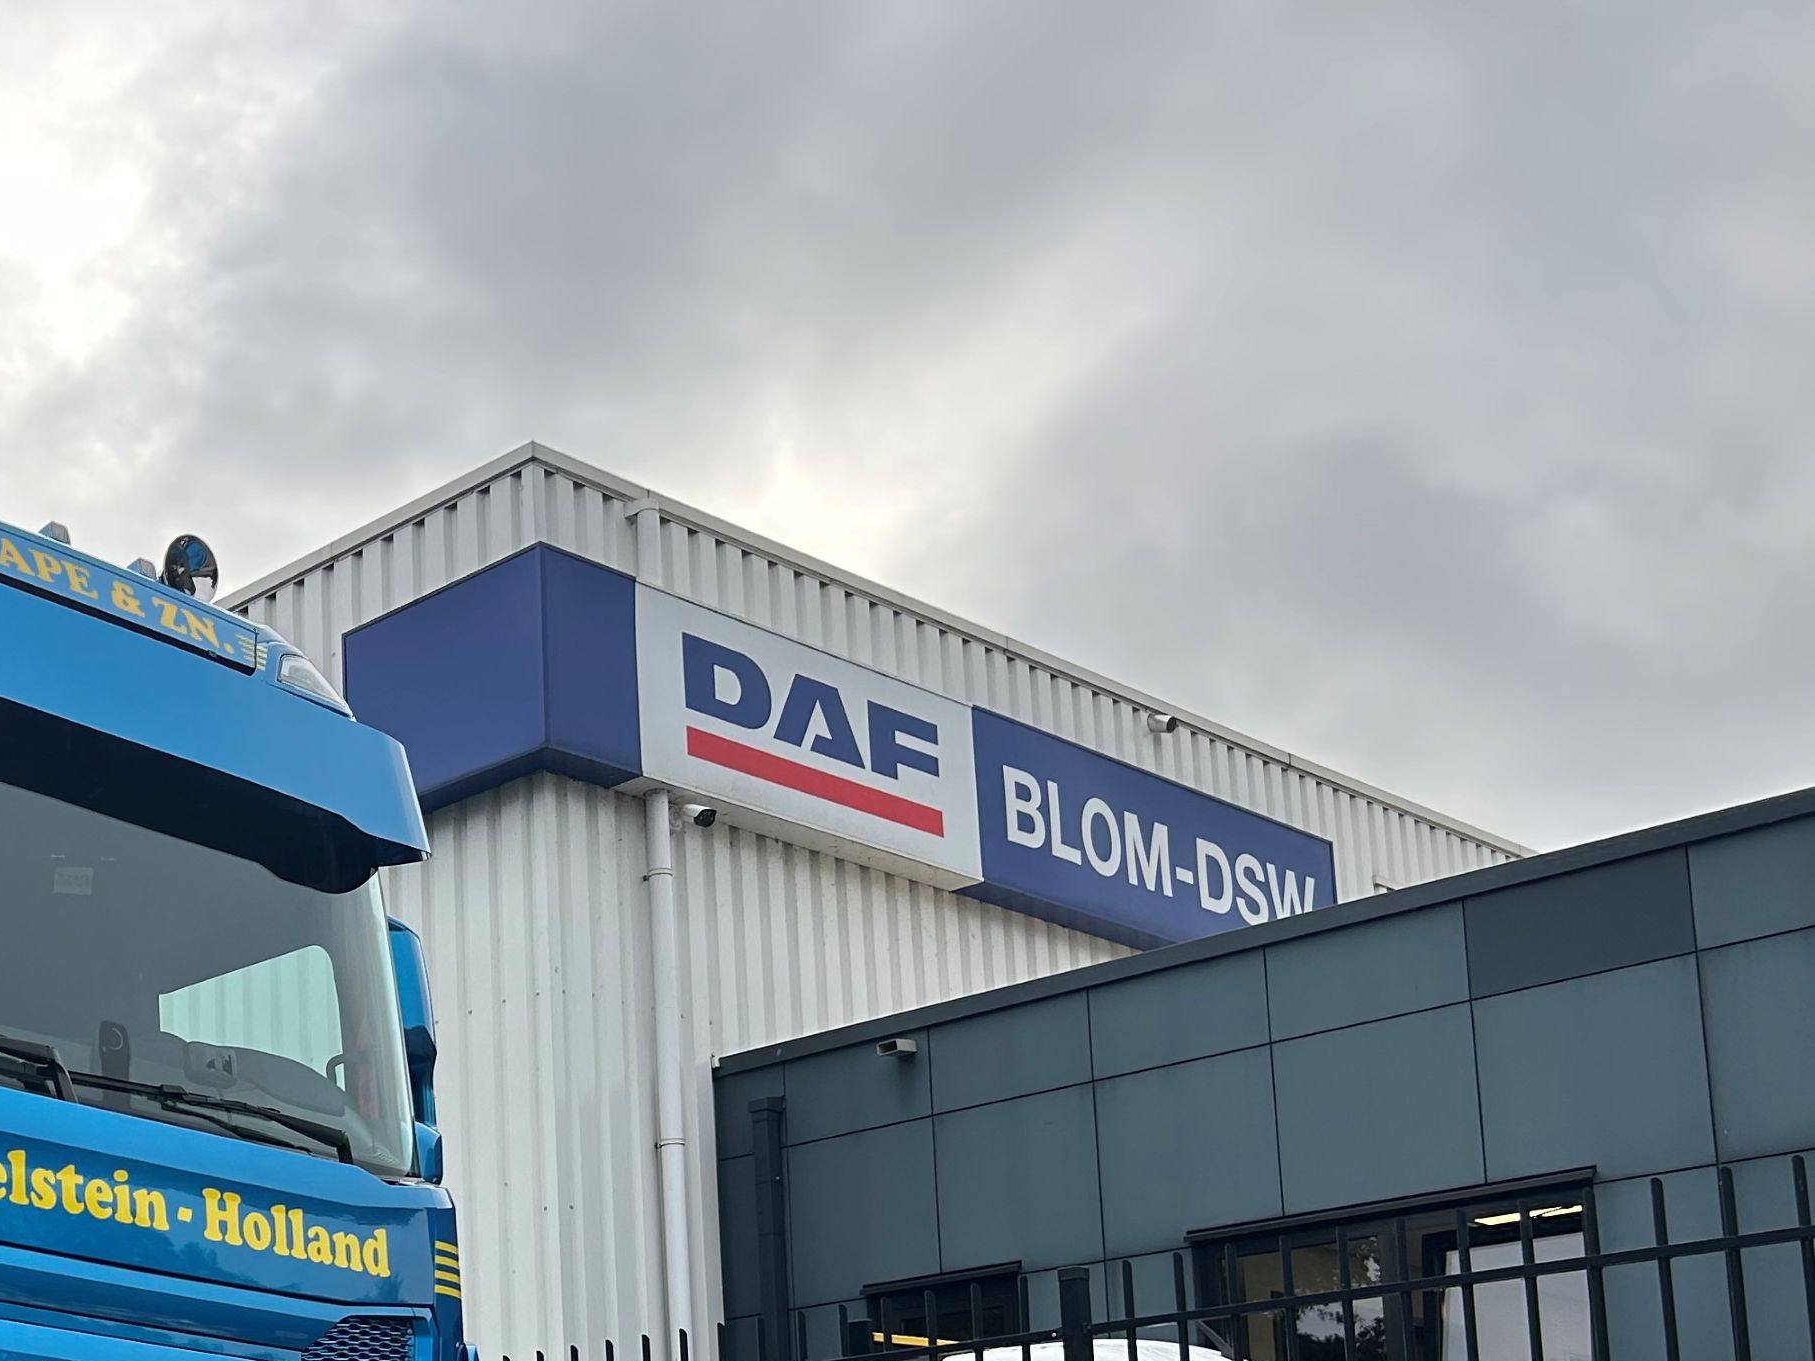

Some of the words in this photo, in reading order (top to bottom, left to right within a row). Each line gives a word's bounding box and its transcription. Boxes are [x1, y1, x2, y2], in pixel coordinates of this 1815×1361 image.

[111, 581, 146, 617] &
[151, 597, 235, 655] ZN.
[681, 632, 941, 780] DAF
[1002, 764, 1315, 926] BLOM-DSW
[202, 1187, 391, 1278] Holland
